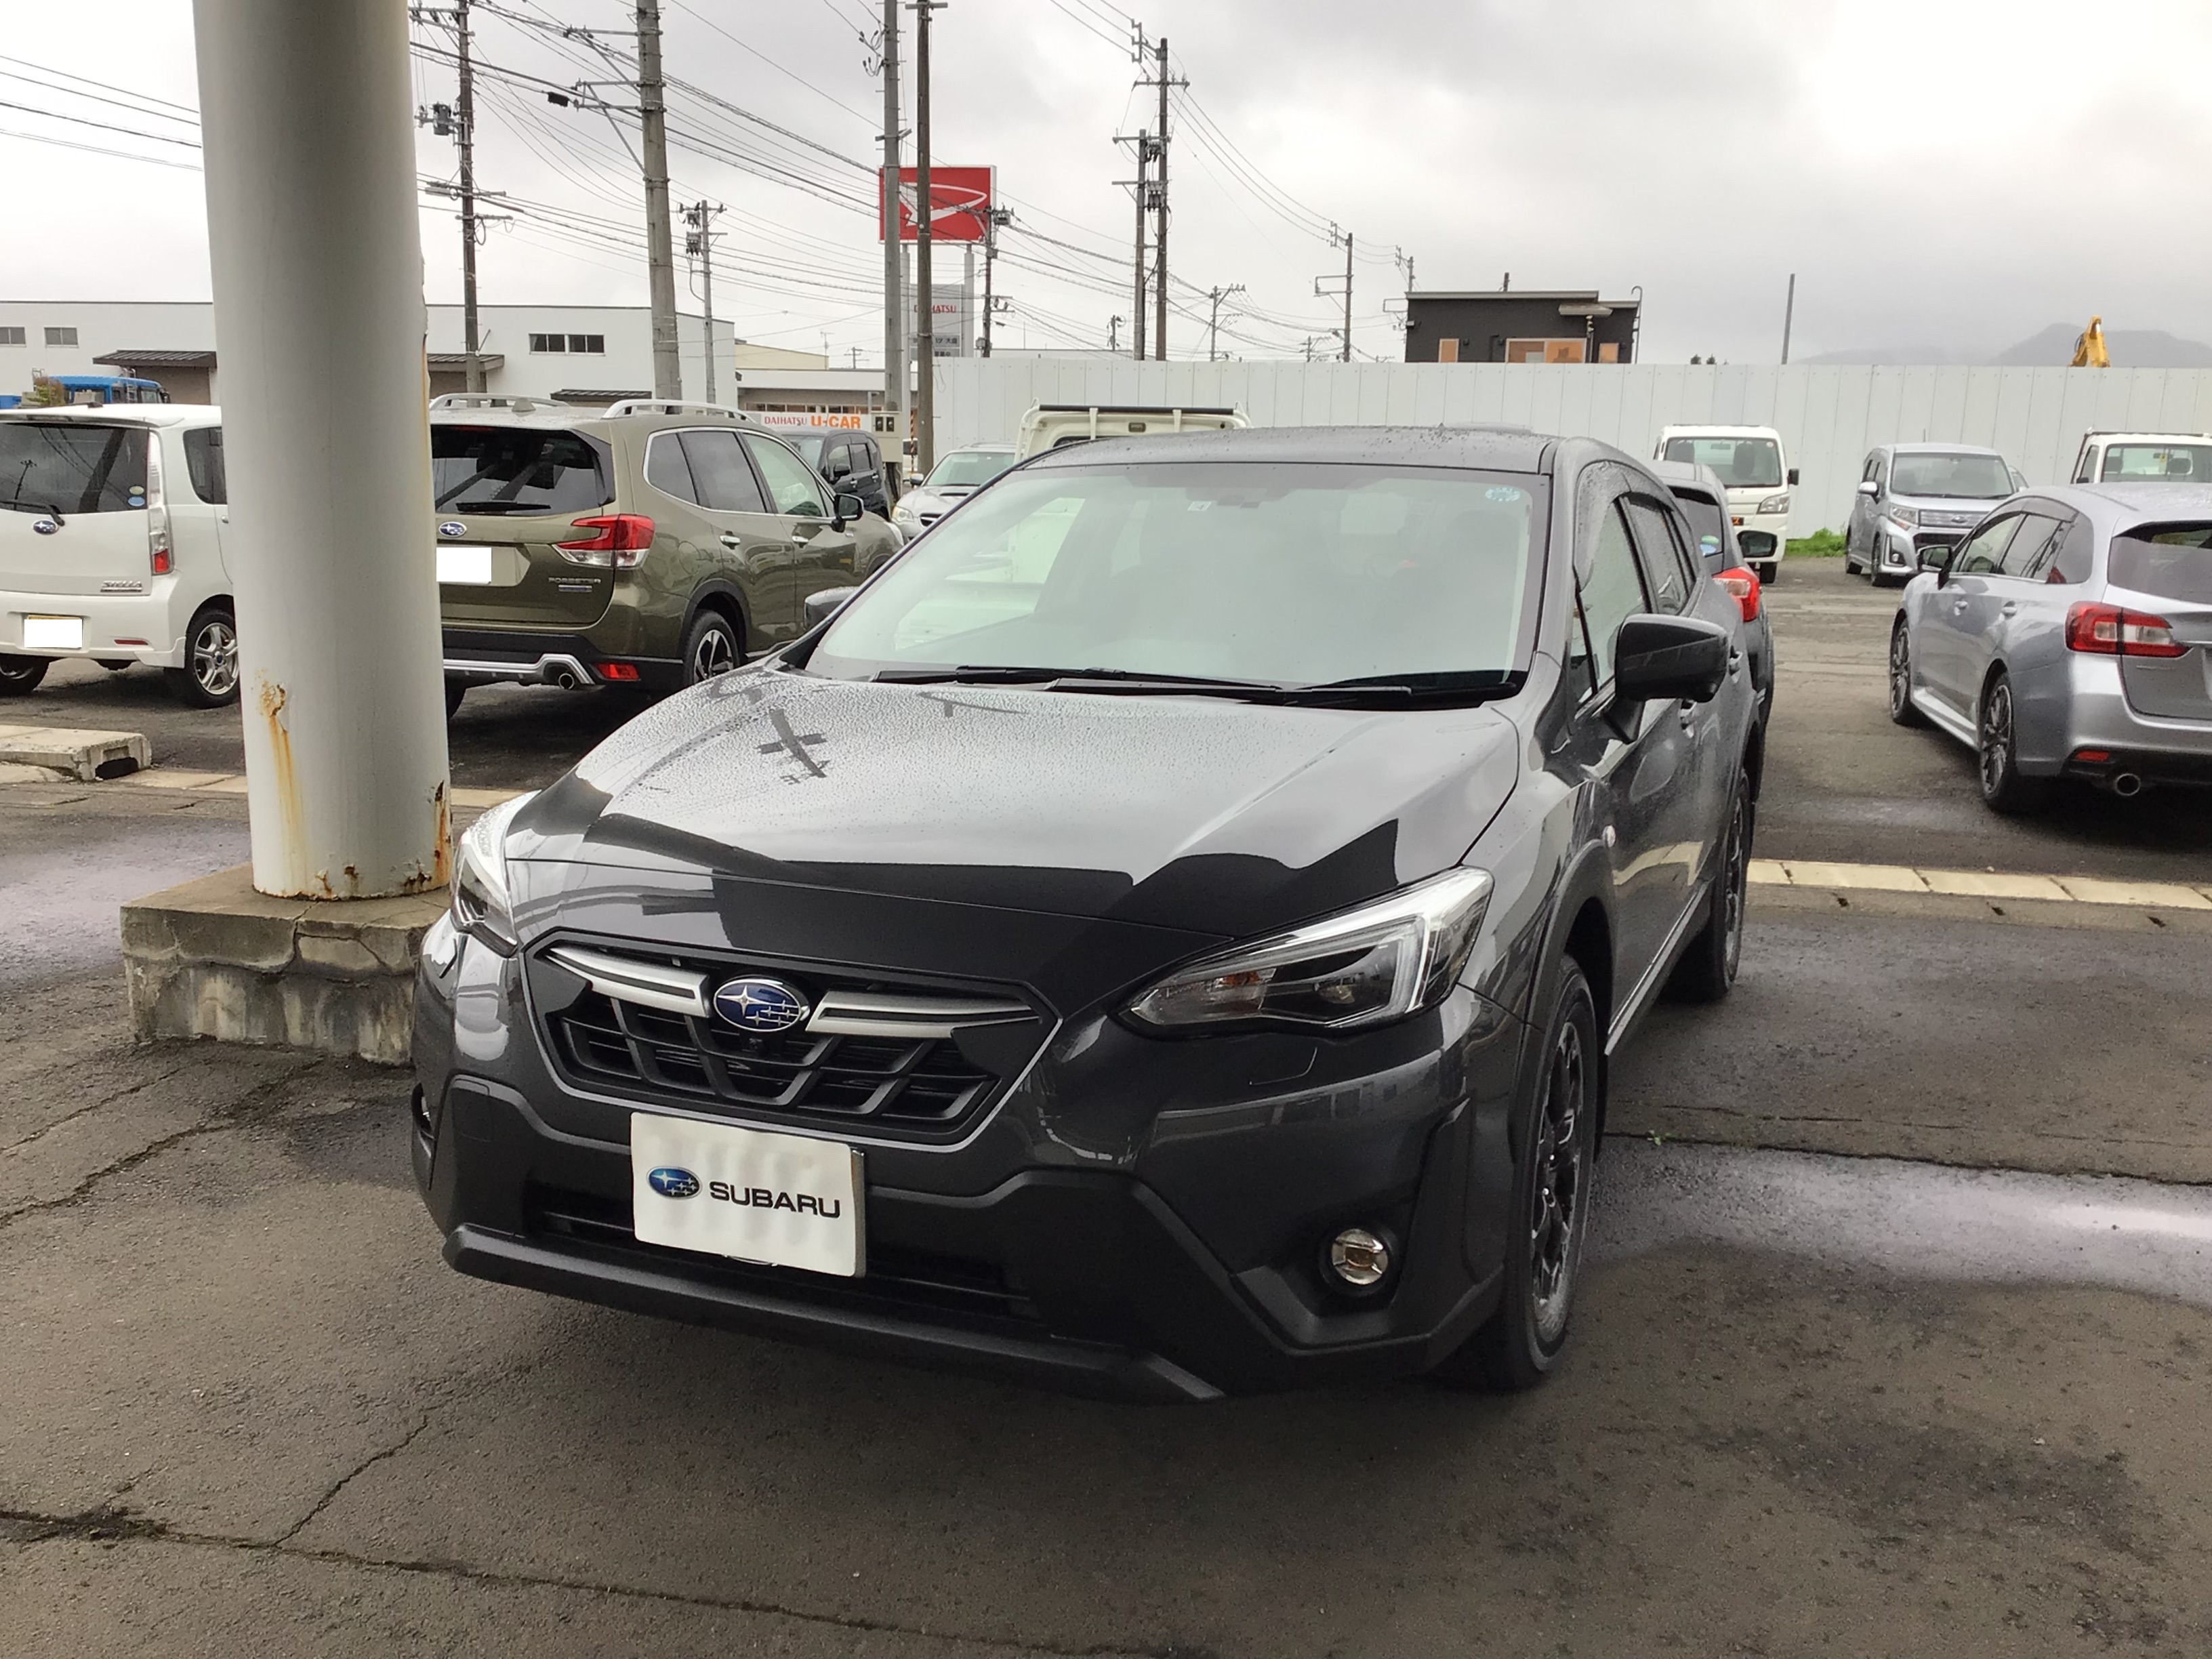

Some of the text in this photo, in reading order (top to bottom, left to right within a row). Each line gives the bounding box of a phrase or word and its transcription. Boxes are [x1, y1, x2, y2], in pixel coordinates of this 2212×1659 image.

[764, 415, 861, 429] DAIHATSU U-CAR
[710, 1181, 840, 1218] SUBARU
